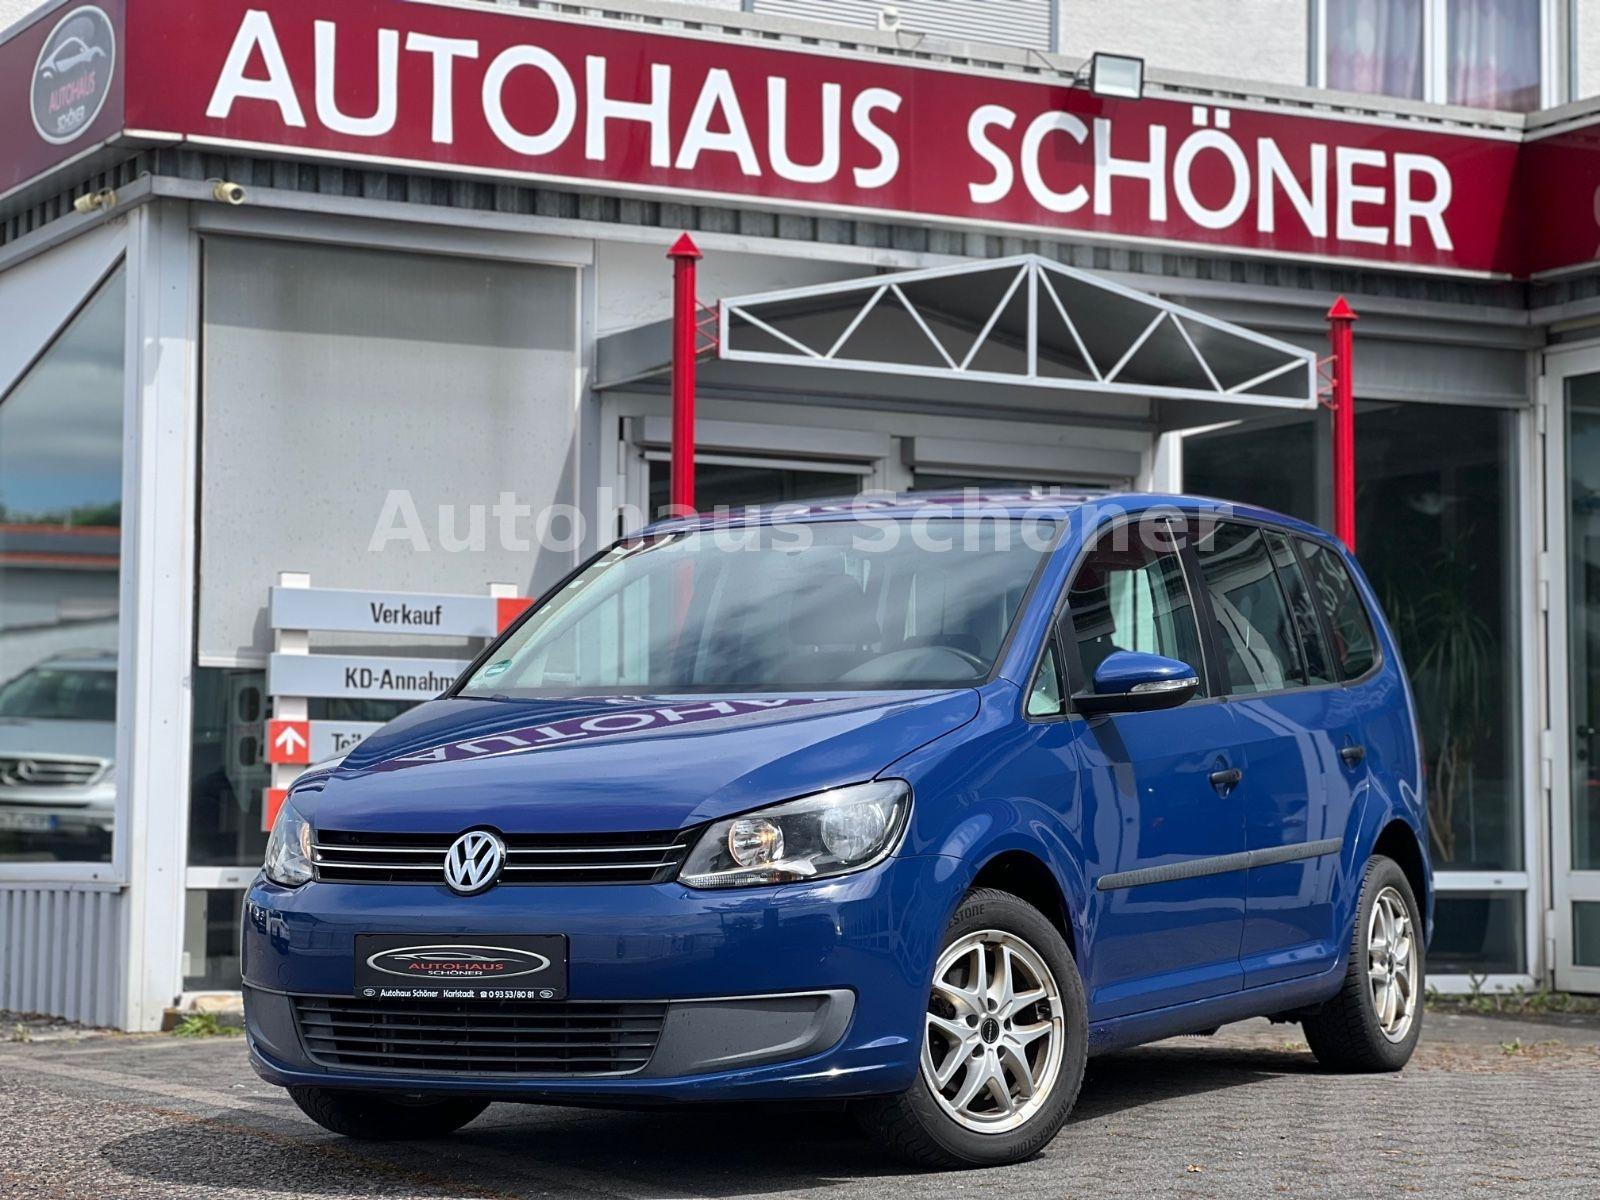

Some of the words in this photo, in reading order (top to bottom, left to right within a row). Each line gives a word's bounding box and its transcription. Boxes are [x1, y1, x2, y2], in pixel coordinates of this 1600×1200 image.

[49, 70, 95, 113] AUTOHAUS
[206, 10, 901, 190] AUTOHAUS
[967, 105, 1453, 251] SCHÖNER
[370, 602, 442, 626] Verkauf
[408, 962, 505, 971] AUTOHAUS
[380, 988, 411, 998] Autohaus
[412, 989, 439, 998] Schöner
[443, 989, 475, 999] Karlstadt
